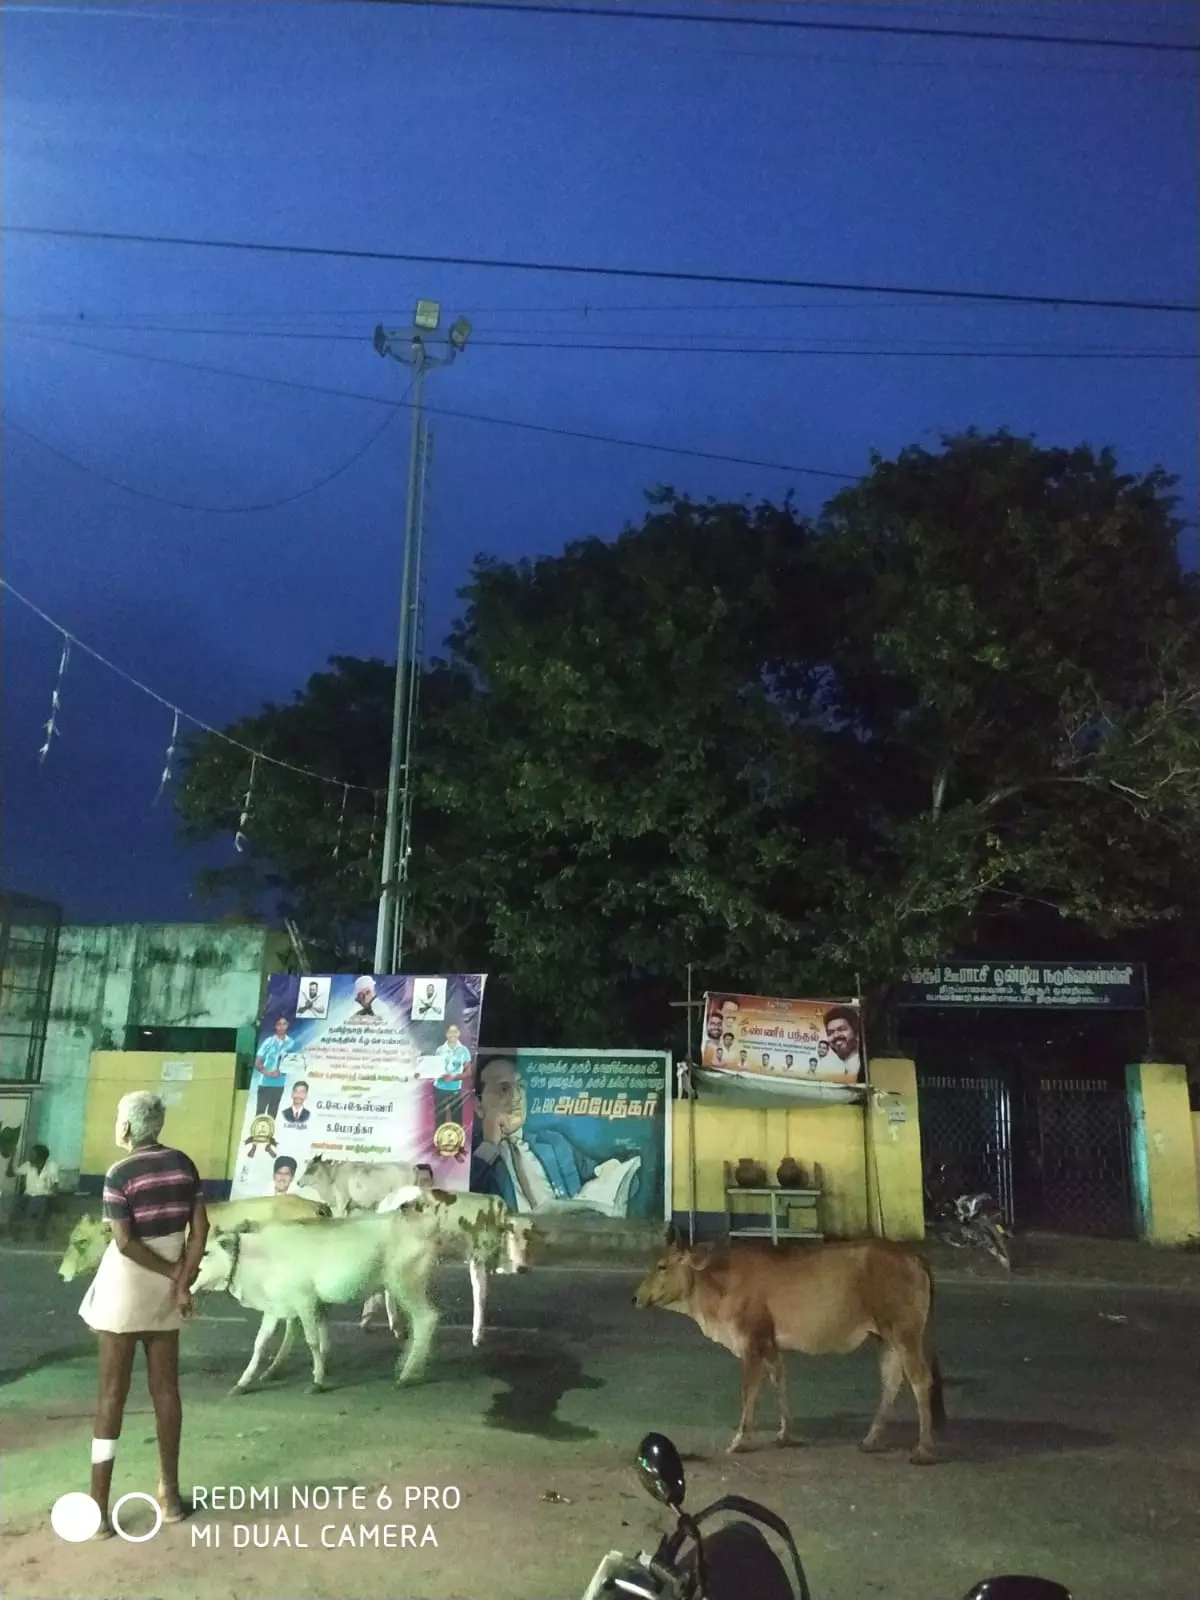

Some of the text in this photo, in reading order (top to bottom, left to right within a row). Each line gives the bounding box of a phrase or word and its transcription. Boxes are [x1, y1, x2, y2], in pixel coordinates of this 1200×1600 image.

[943, 964, 990, 984] ஊராட்சி
[993, 964, 1040, 987] ஒன்றிய
[741, 1025, 820, 1043] தண்ணீர் பந்தல்
[554, 1092, 658, 1120] அம்பேத்கர்
